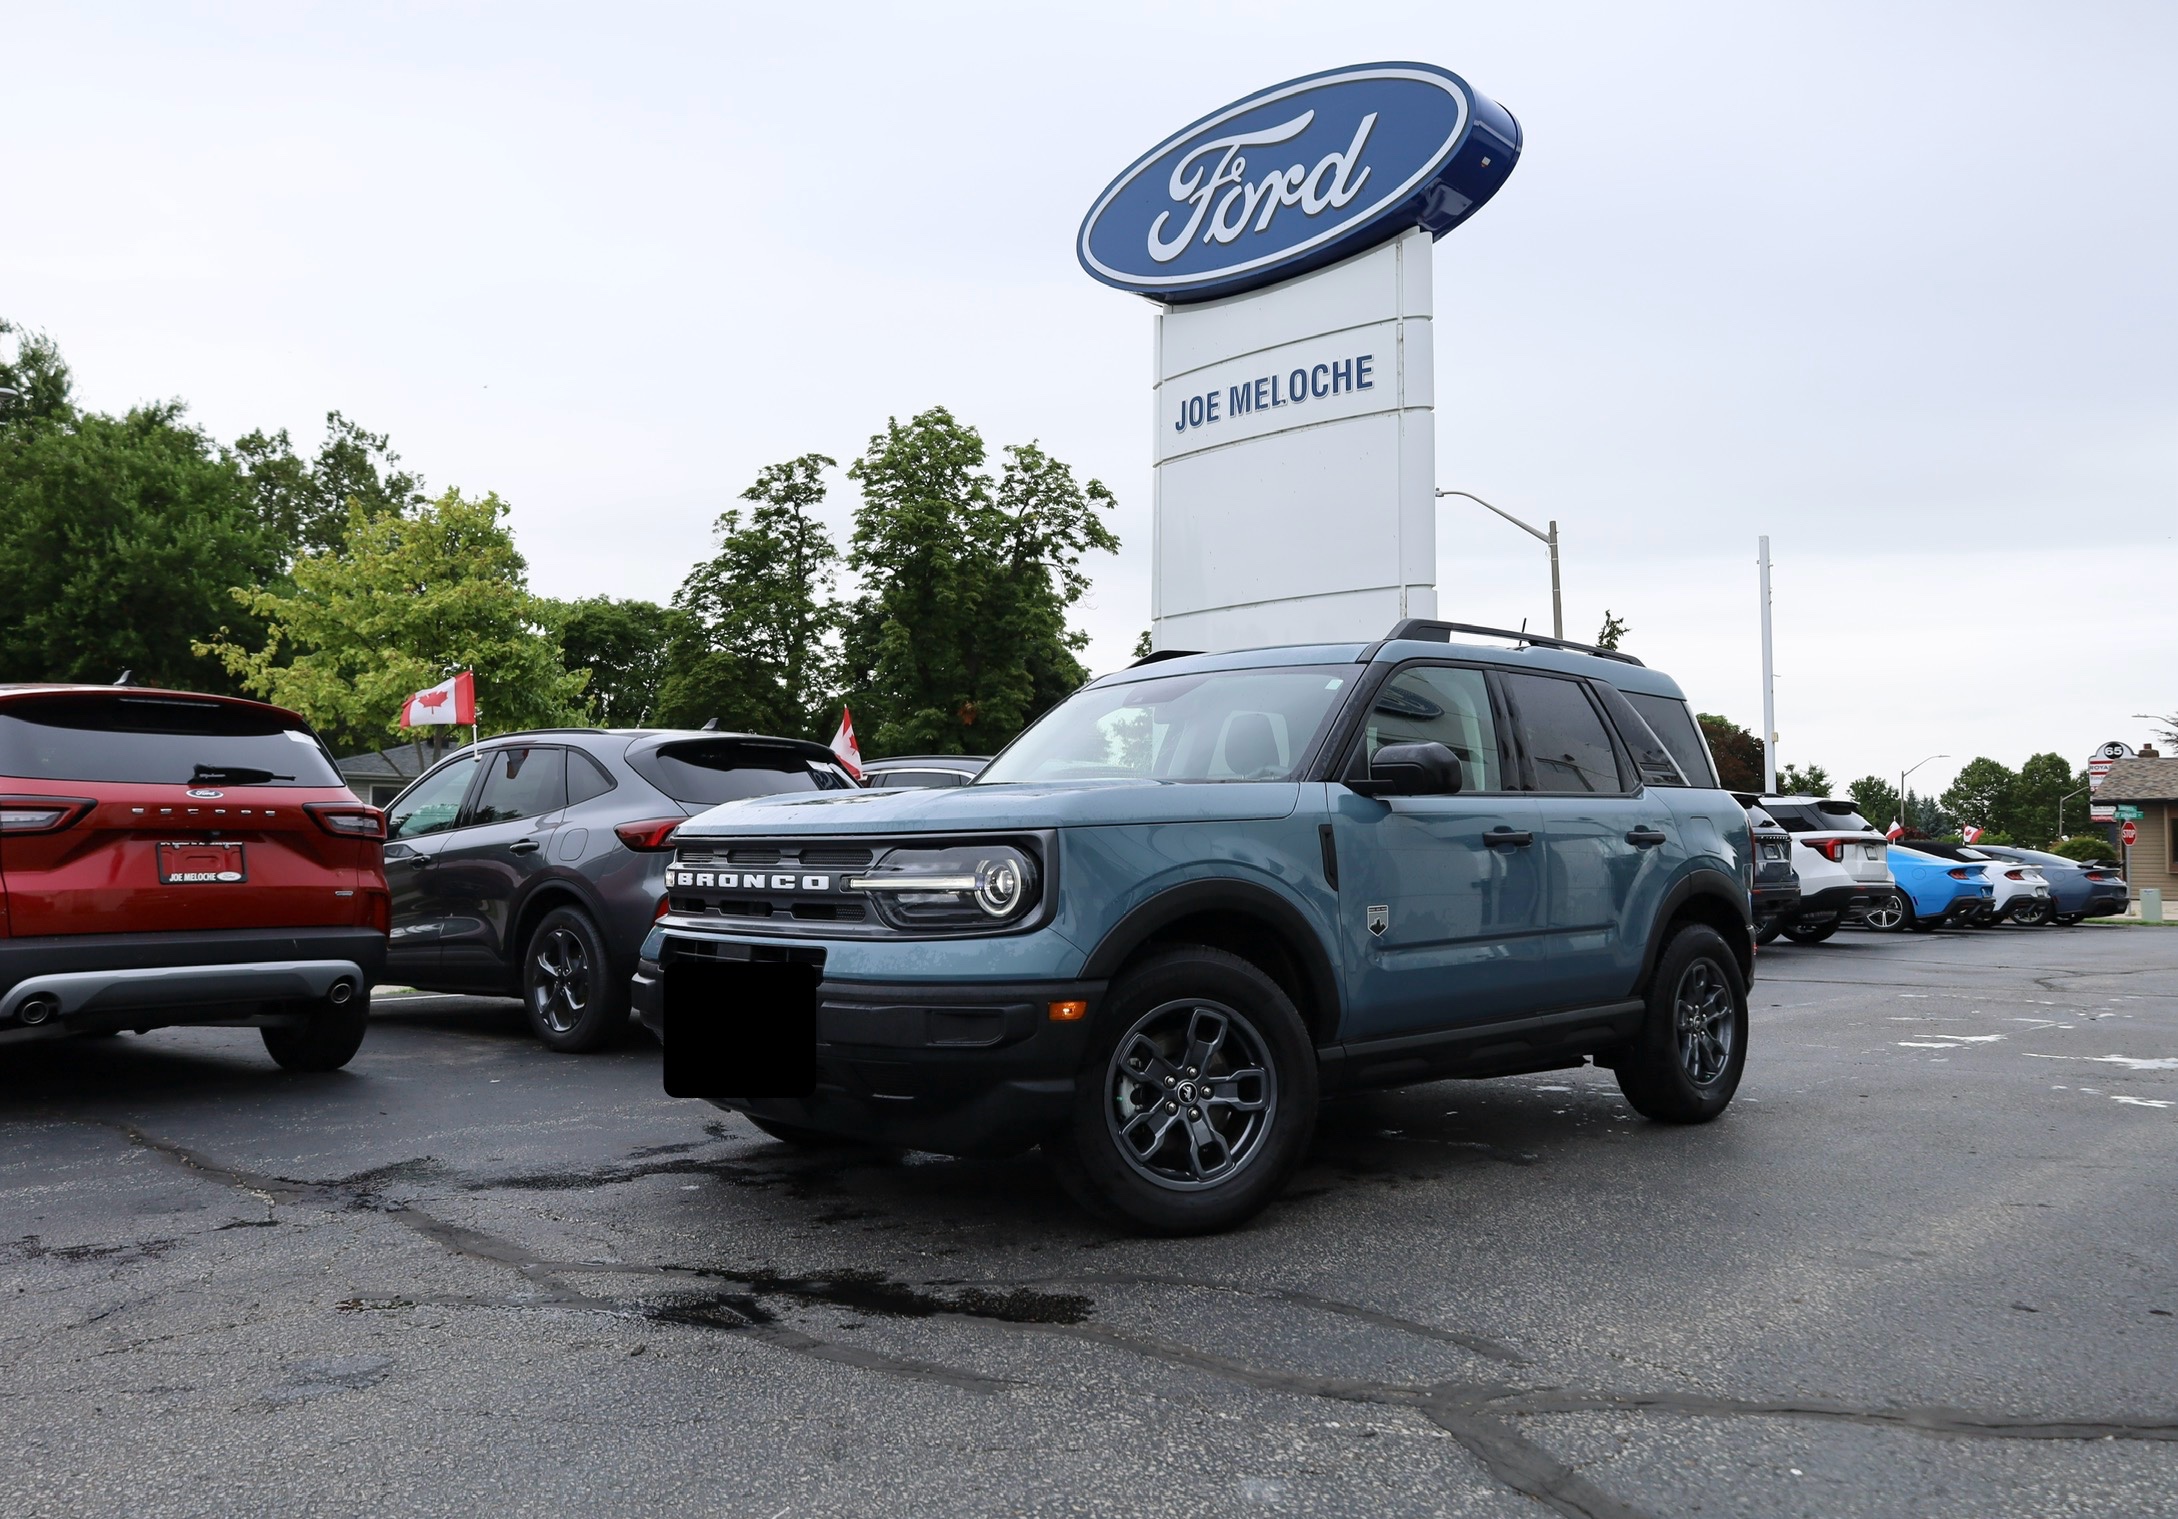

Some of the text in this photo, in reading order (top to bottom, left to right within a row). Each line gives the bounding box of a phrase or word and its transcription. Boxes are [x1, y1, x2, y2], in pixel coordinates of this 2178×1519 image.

[1147, 109, 1378, 262] Ford
[1174, 354, 1374, 432] JOE MELOCHE
[2104, 746, 2123, 756] 65
[2122, 829, 2136, 838] STOP
[169, 872, 183, 882] JOE
[183, 872, 217, 881] MELOCHE
[677, 872, 830, 891] BRONCO
